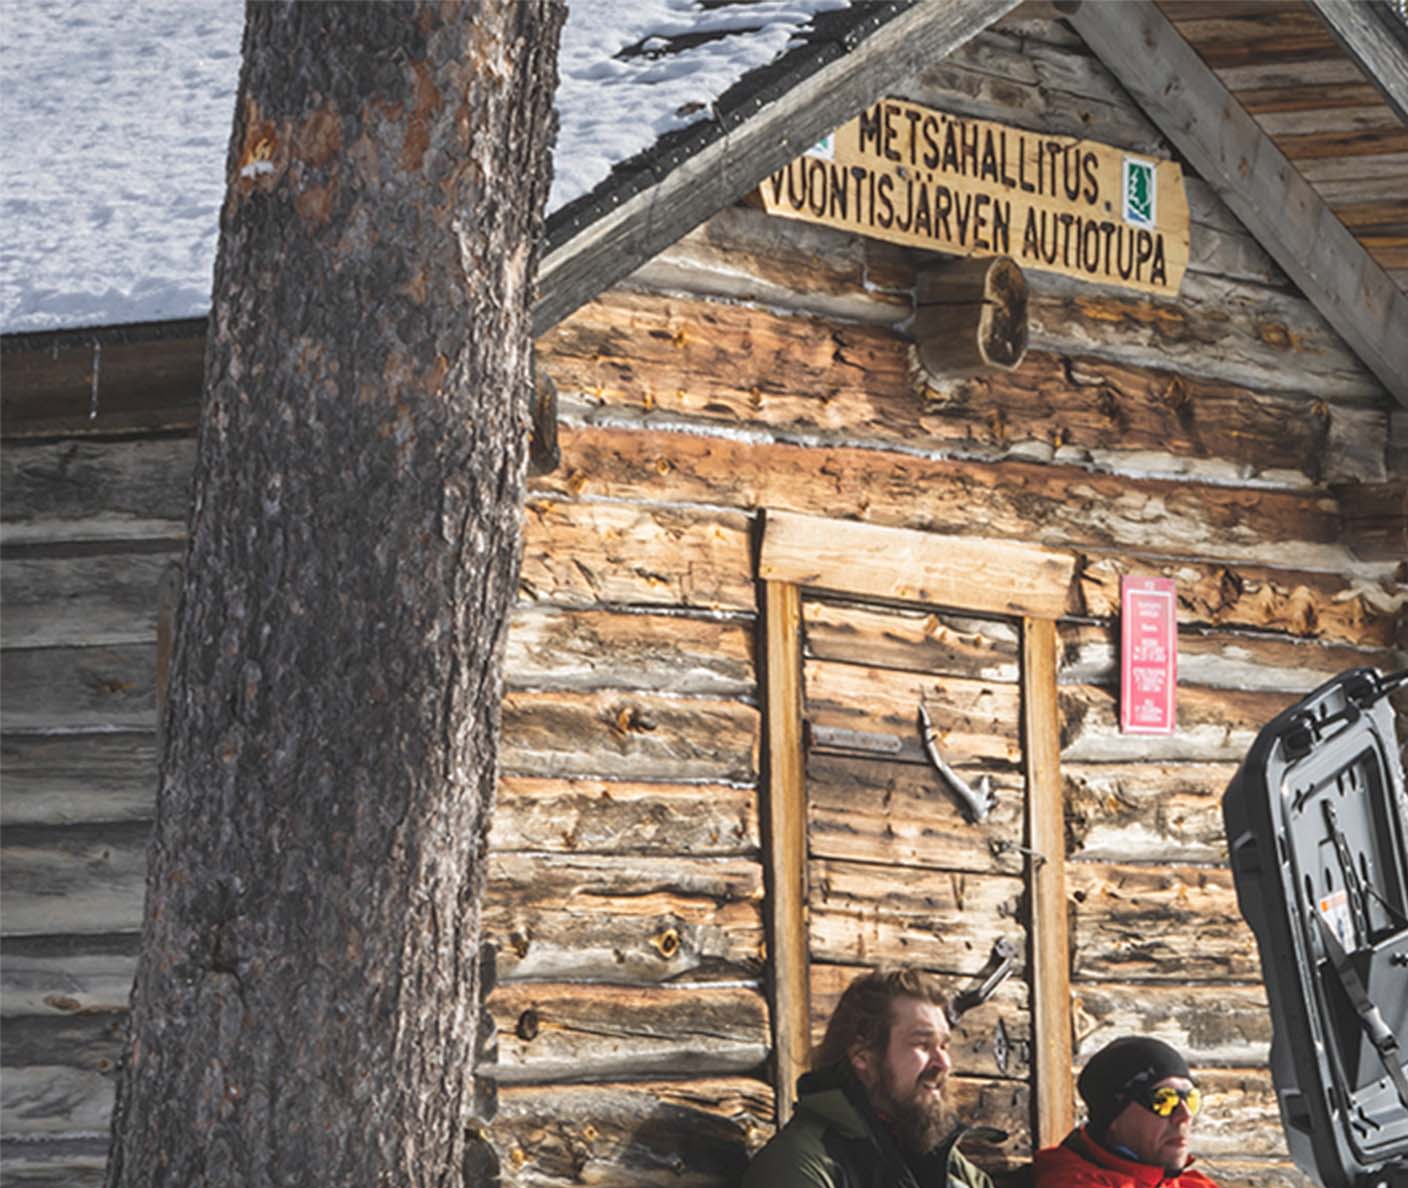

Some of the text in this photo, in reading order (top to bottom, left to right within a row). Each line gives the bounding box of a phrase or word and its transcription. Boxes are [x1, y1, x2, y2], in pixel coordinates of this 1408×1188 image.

[859, 103, 1099, 204] METSÄHALLITUS
[770, 157, 1167, 286] VUONTISJÄRVEN AUTIOTUPA
